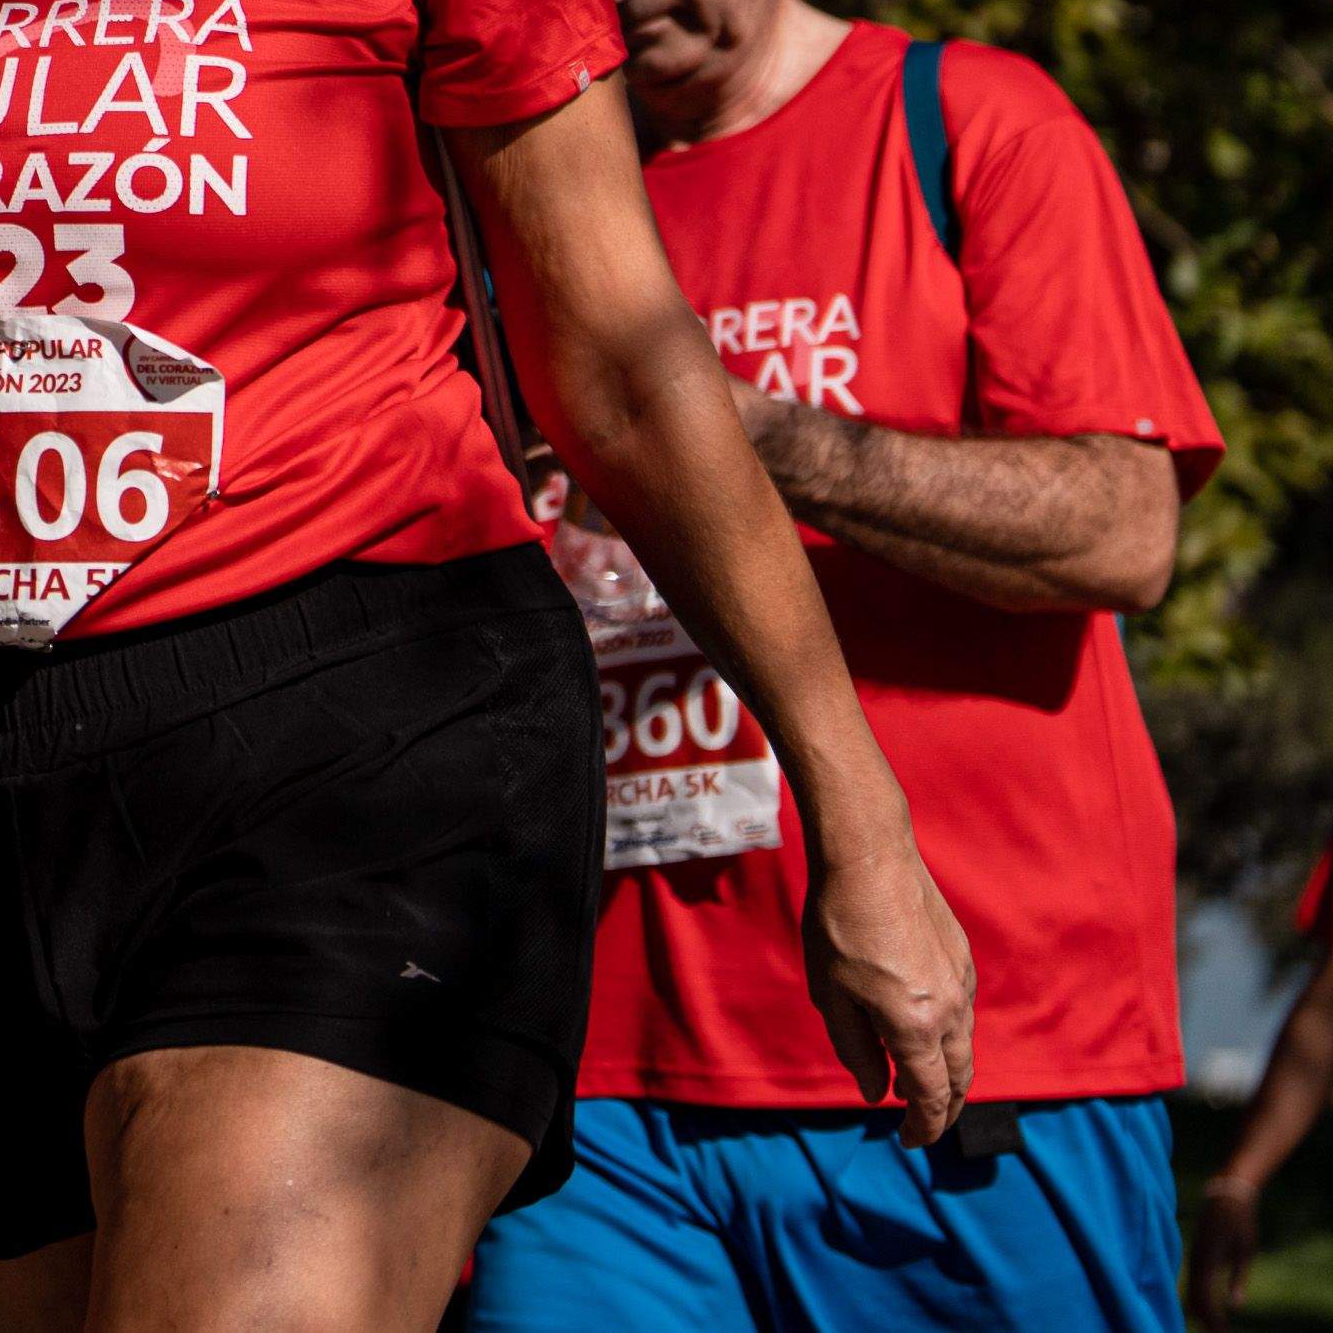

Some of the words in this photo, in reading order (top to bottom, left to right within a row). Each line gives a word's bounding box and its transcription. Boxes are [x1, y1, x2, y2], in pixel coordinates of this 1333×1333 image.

[701, 292, 862, 356] RERA
[28, 372, 82, 394] 2023
[85, 568, 122, 601] 5
[685, 769, 723, 798] 5K
